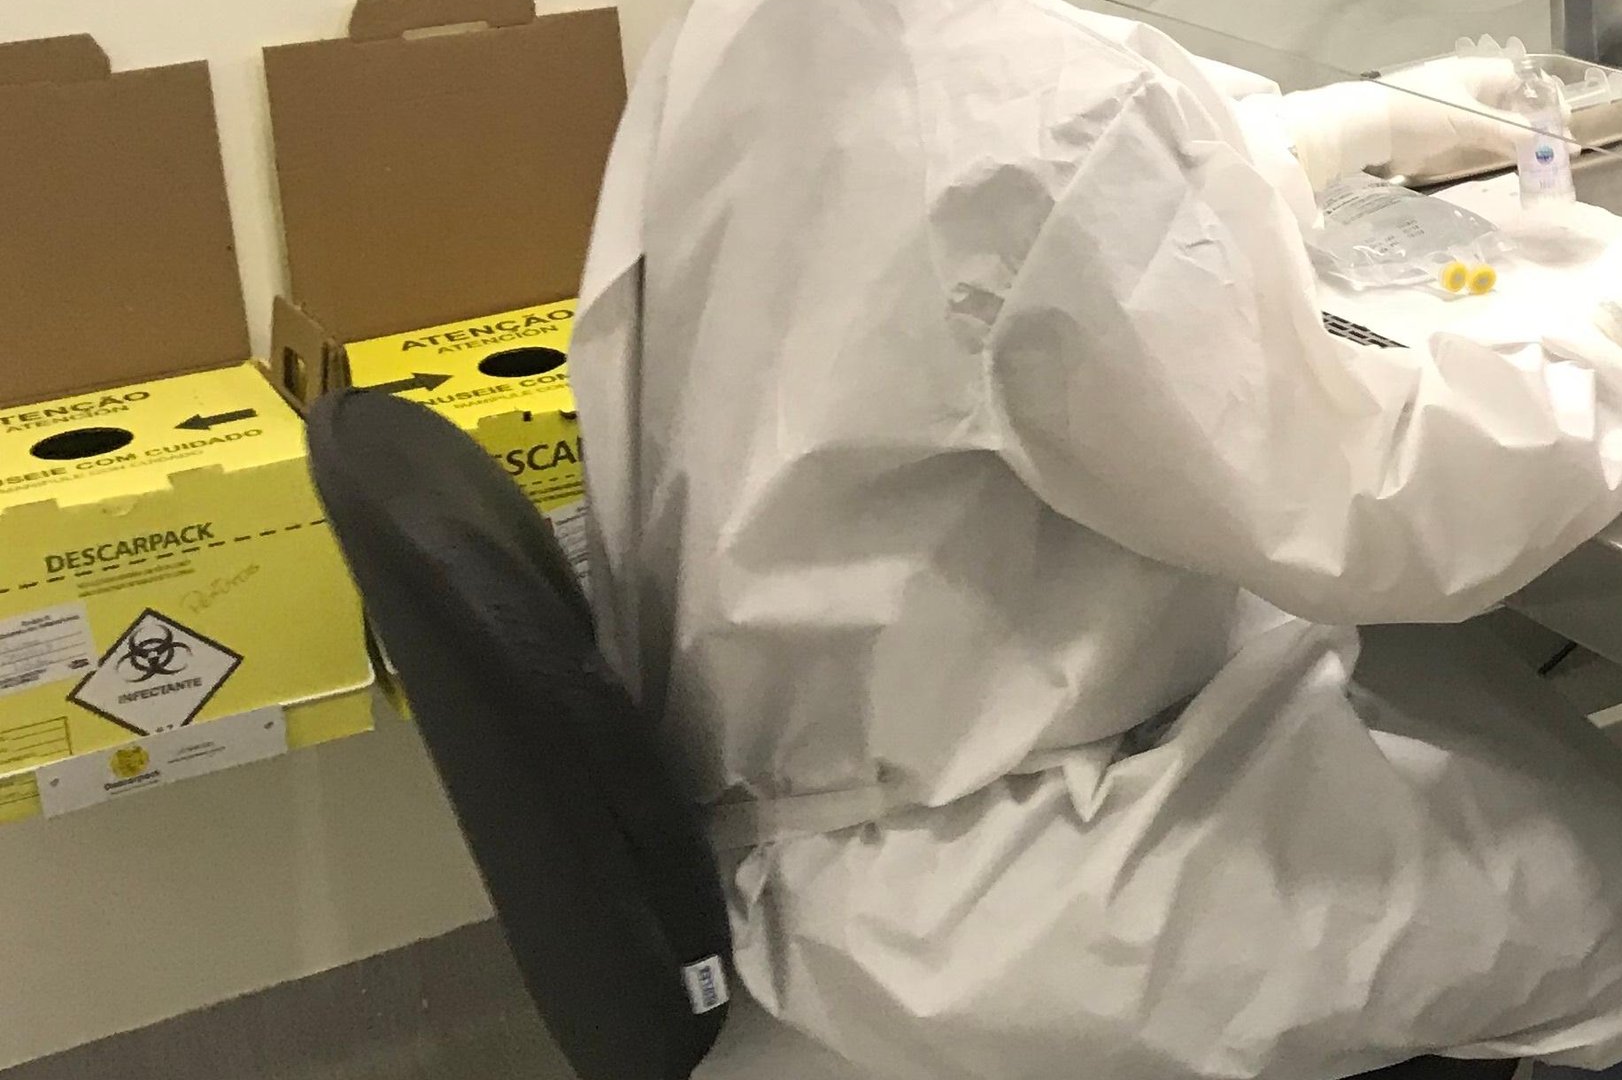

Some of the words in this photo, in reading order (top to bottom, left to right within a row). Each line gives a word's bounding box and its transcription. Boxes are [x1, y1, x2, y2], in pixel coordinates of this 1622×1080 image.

[401, 308, 575, 352] ATENÇÃO
[0, 391, 151, 426] TENÇÃO
[417, 383, 514, 406] NUSEIE
[75, 453, 138, 471] COM
[144, 428, 264, 458] CUIDADO
[45, 522, 215, 574] DESCARPACK
[117, 677, 203, 705] INFECTANTE
